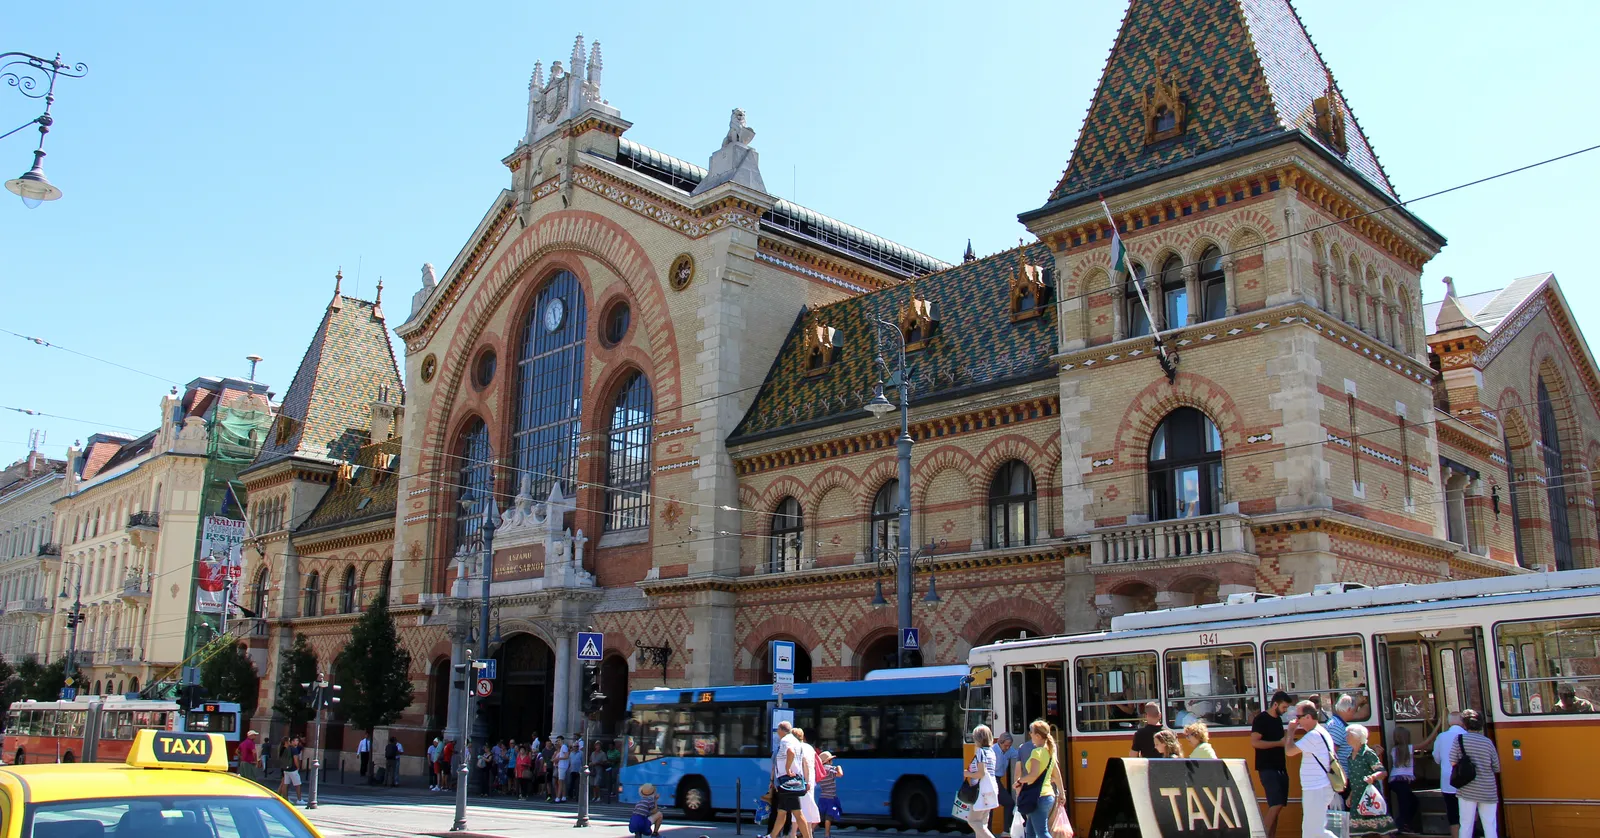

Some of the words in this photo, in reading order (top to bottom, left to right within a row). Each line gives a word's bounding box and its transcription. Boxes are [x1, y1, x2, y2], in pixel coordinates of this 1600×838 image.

[1199, 633, 1218, 646] 1341
[160, 737, 206, 755] TAXI
[1159, 787, 1242, 831] TAXI
